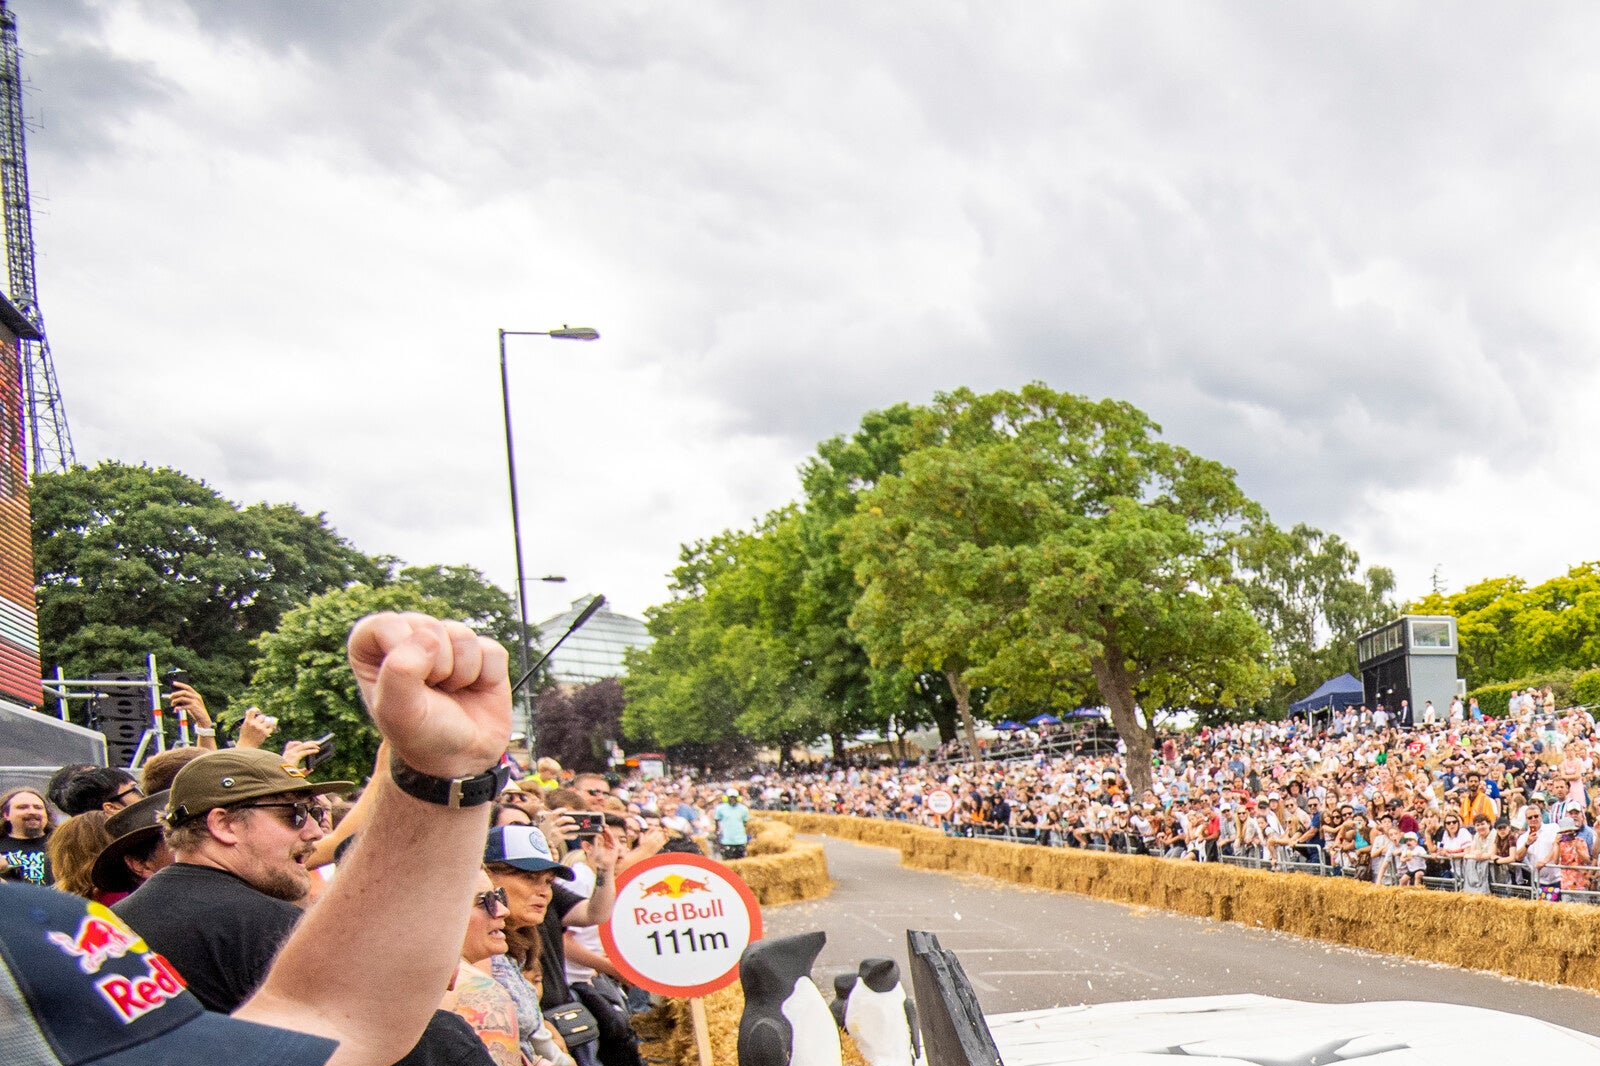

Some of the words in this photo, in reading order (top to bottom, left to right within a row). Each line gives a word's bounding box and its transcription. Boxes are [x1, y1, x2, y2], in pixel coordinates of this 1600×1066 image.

[633, 903, 679, 926] Red
[681, 899, 724, 920] Bull
[646, 927, 729, 956] 111m
[95, 952, 183, 1024] Red
